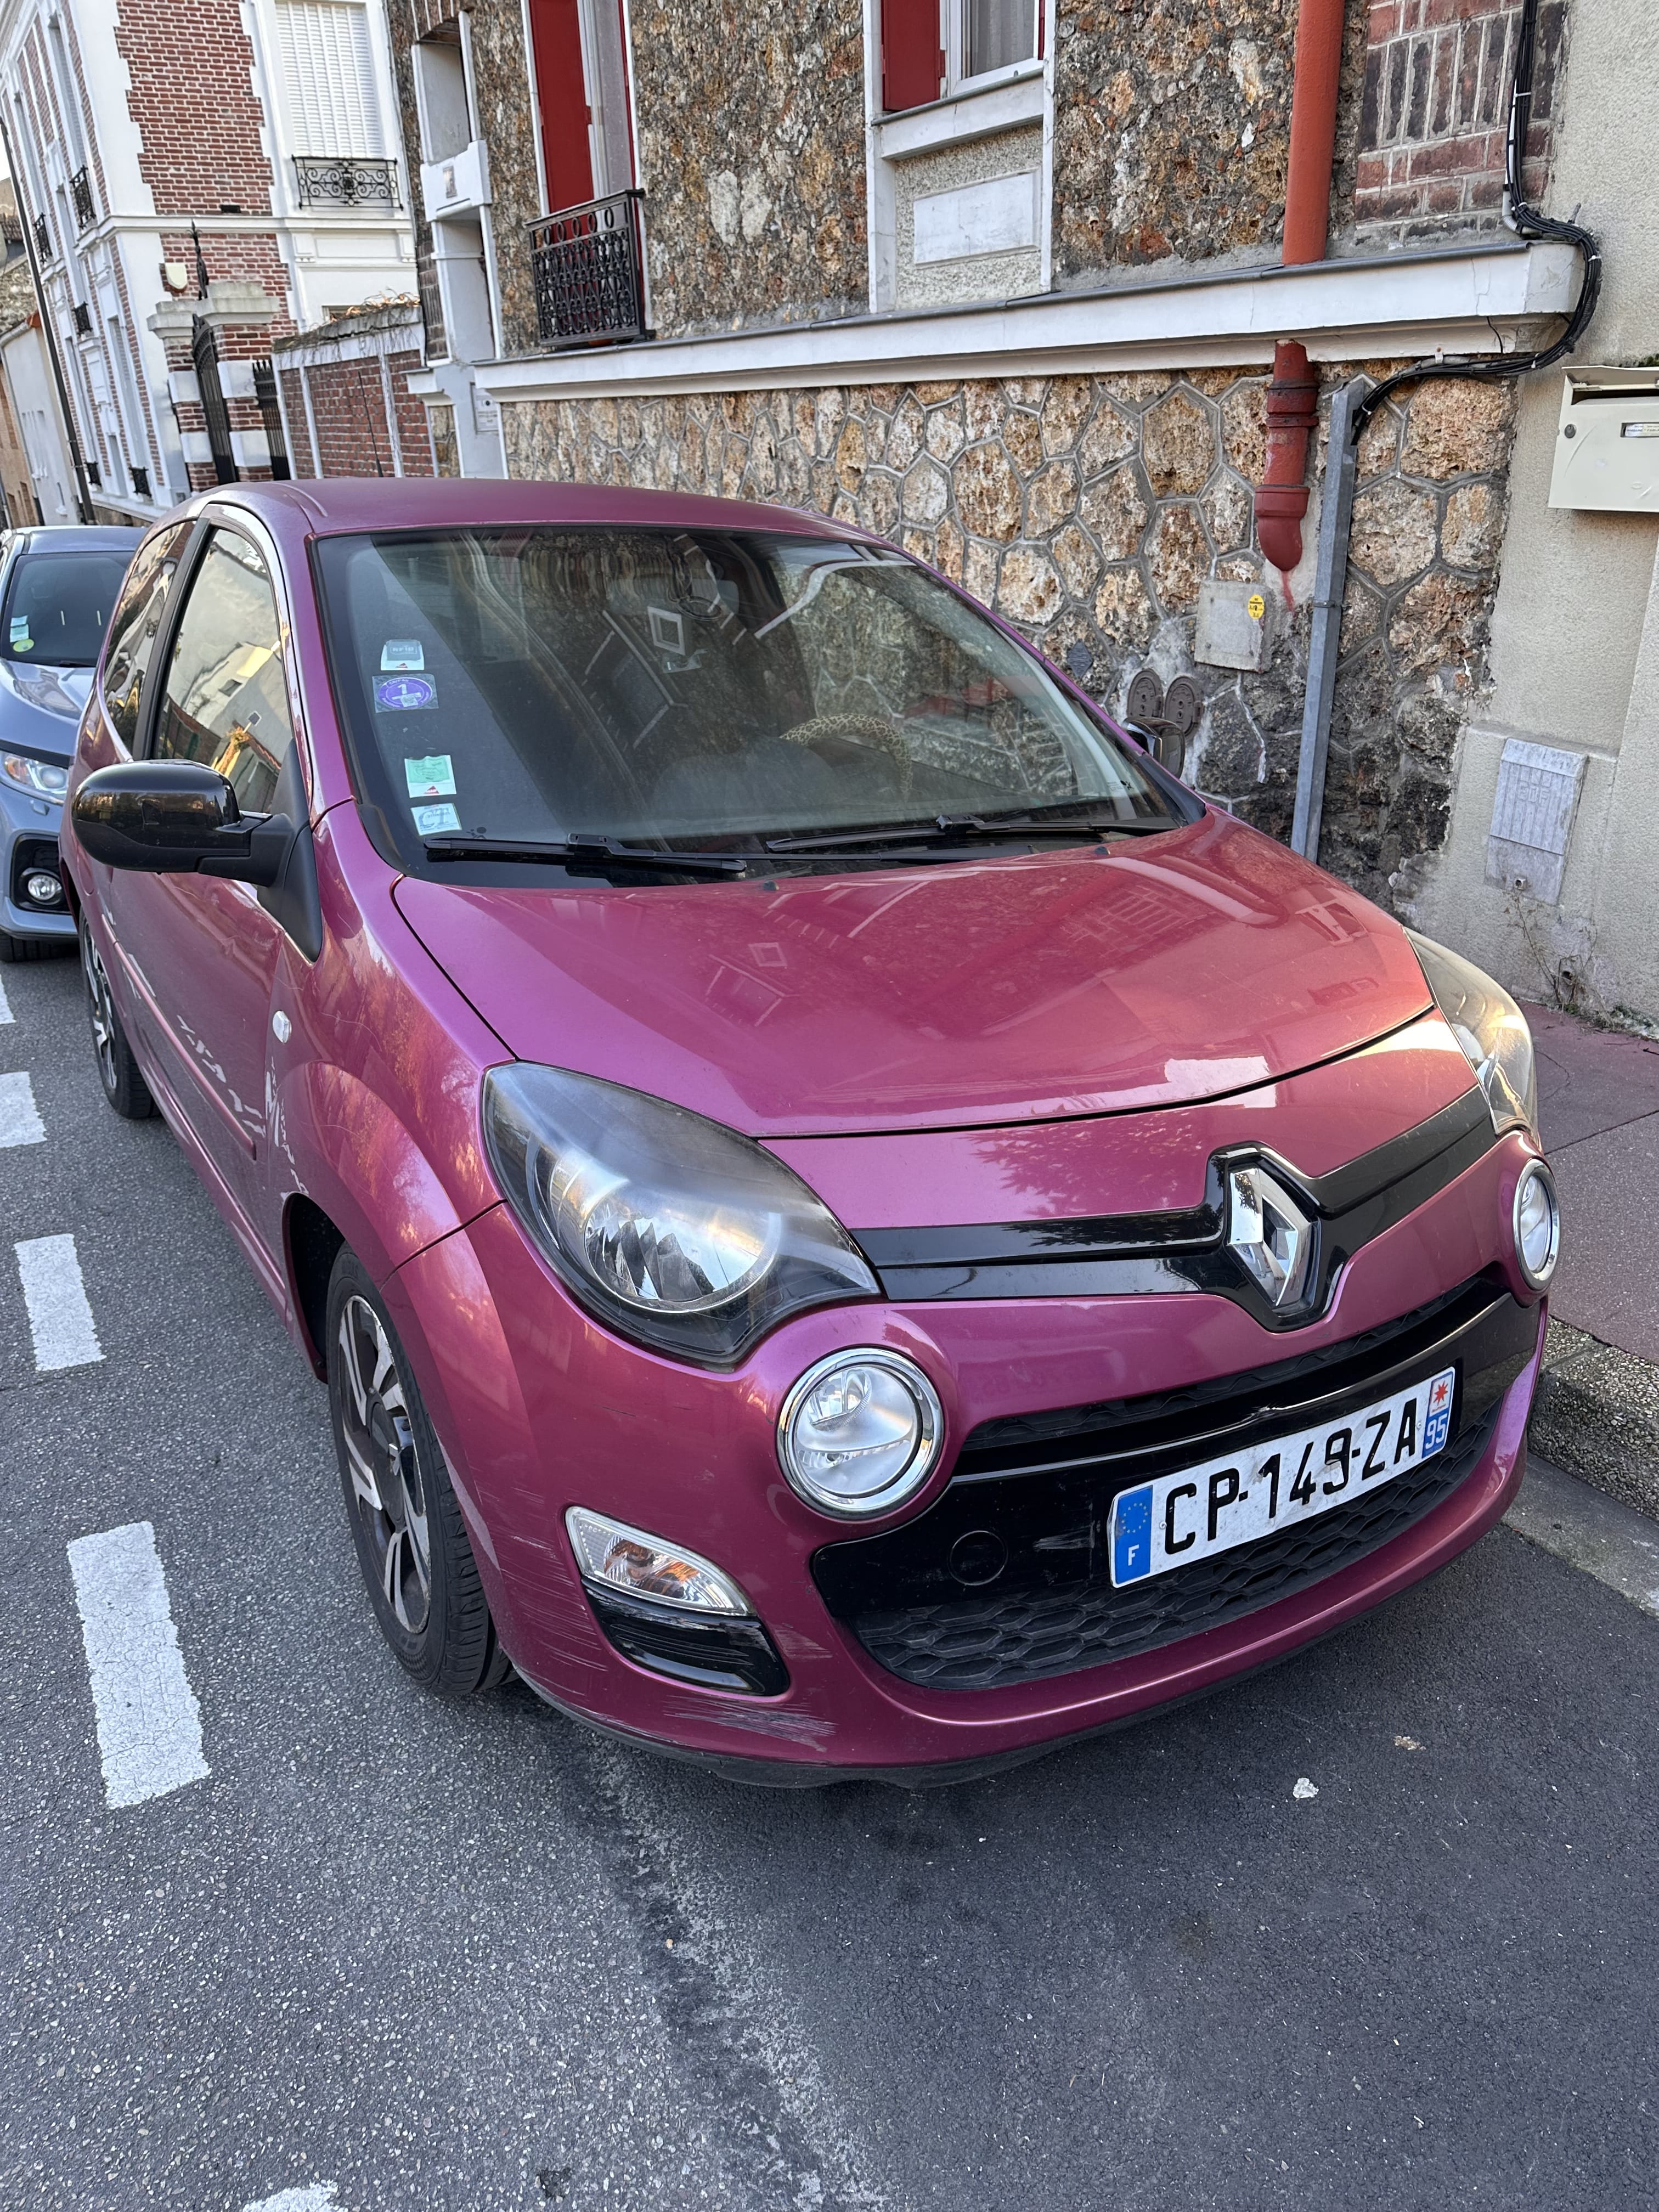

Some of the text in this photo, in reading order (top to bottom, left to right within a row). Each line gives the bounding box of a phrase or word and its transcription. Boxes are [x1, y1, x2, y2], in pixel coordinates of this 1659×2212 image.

[398, 684, 408, 695] 1
[1425, 1413, 1448, 1449] 95
[1164, 1397, 1417, 1555] CP-149-ZA
[1127, 1544, 1139, 1566] F
